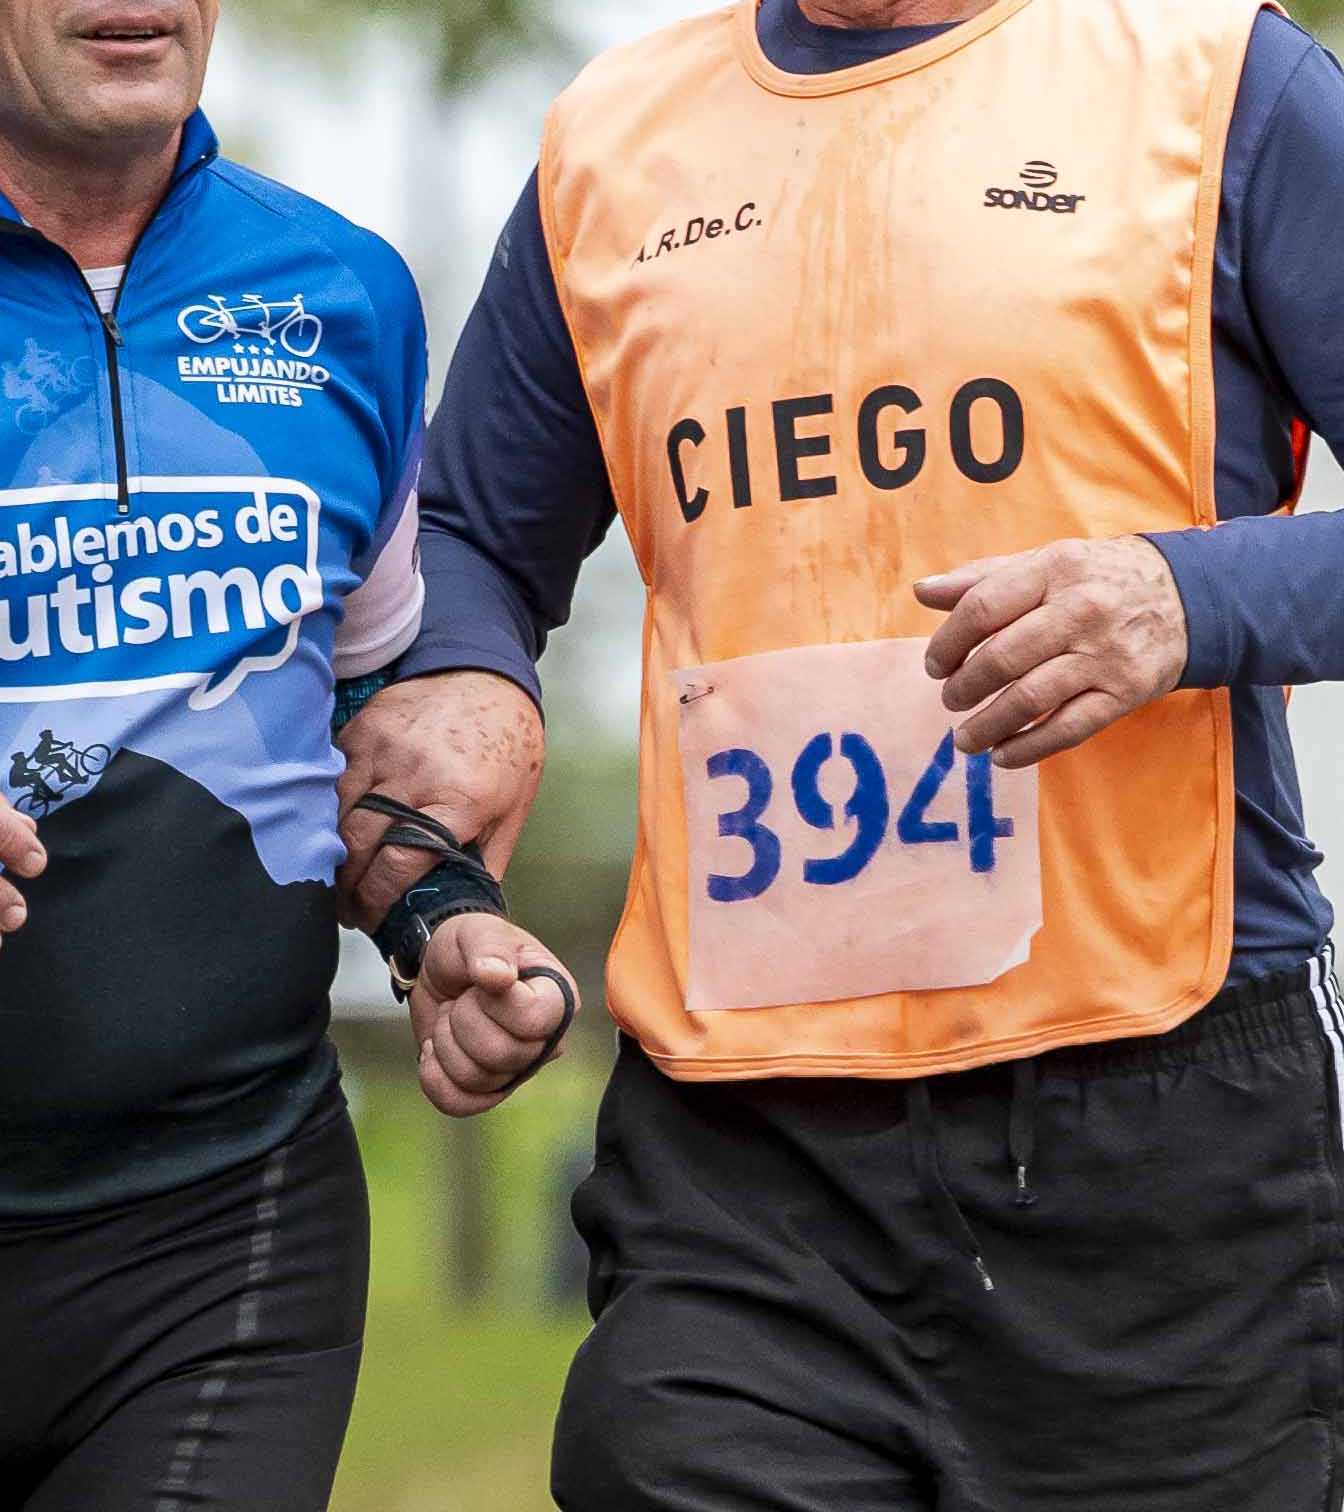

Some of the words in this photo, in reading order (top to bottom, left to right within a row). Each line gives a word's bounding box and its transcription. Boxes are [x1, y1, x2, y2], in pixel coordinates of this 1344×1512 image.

[177, 355, 331, 384] EMPUJANDO
[216, 383, 304, 408] LIMITES
[666, 377, 1025, 524] CIEGO
[235, 493, 299, 544] de
[706, 727, 1015, 902] 394
